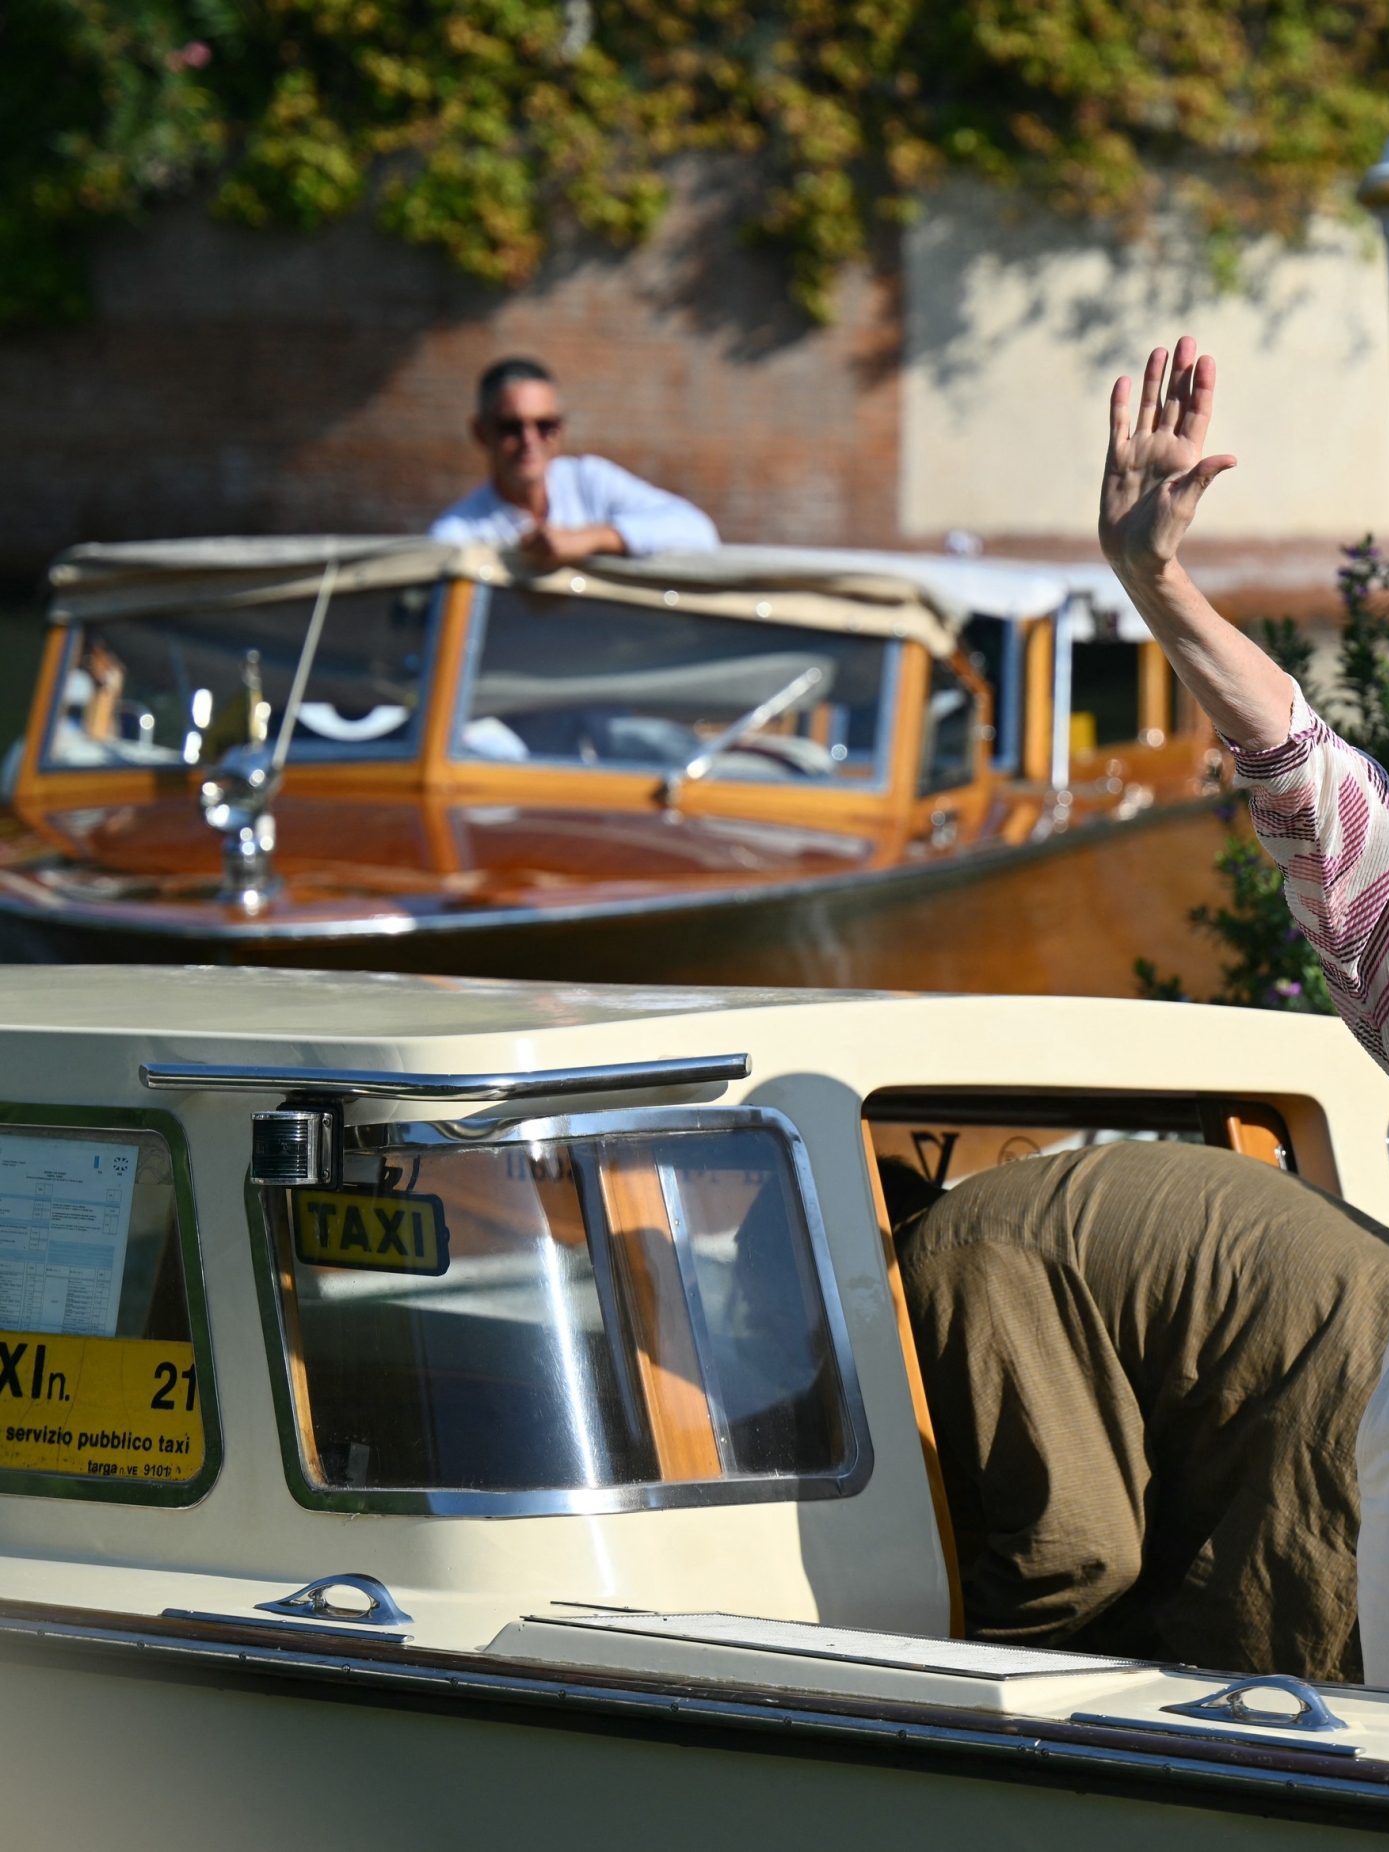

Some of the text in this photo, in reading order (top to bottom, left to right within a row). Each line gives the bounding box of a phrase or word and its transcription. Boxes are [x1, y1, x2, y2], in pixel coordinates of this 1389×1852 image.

[307, 1202, 425, 1258] TAXI
[5, 1425, 190, 1454] servizio pubblico taxi
[88, 1460, 117, 1476] targa
[127, 1466, 138, 1475] VE
